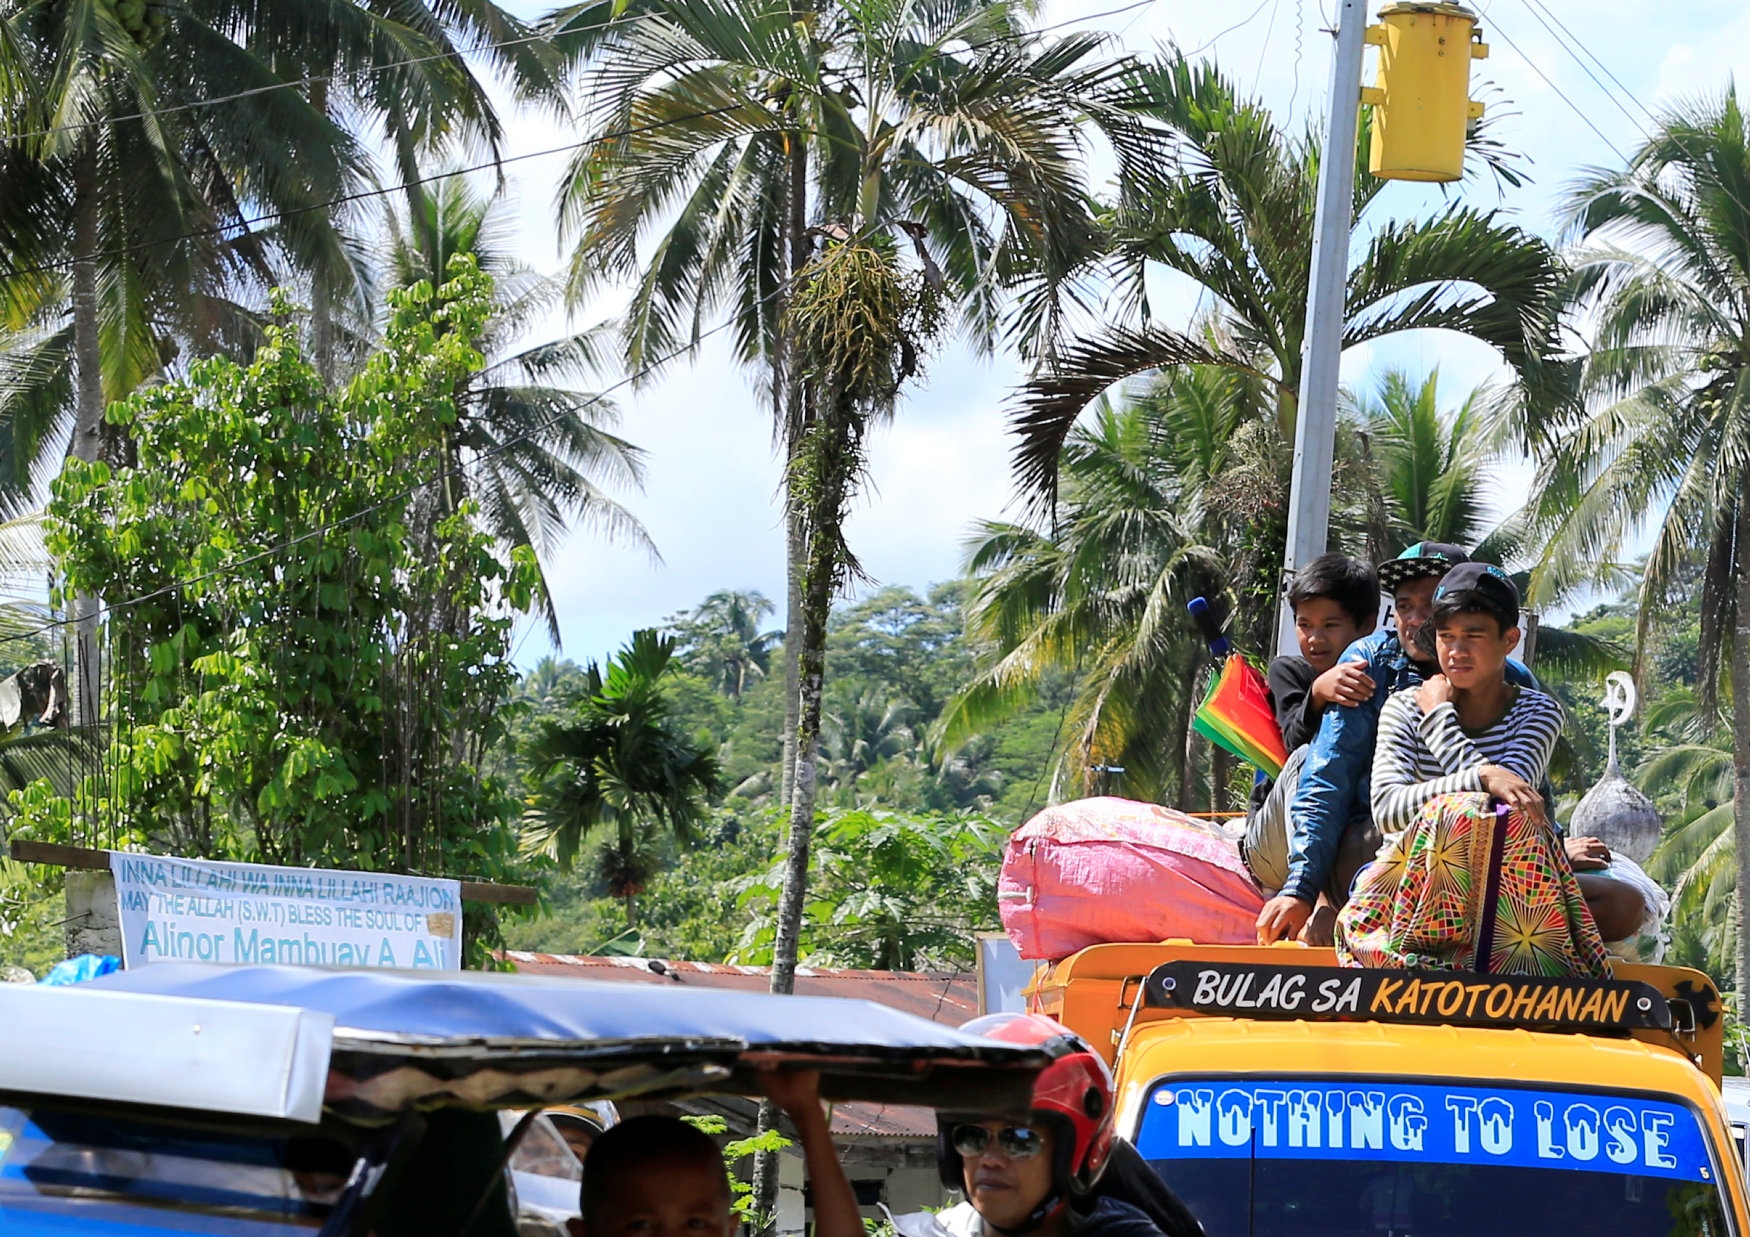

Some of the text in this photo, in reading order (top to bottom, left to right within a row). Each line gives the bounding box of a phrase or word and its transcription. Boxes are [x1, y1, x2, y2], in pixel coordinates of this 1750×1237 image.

[122, 859, 167, 887] INNA
[171, 864, 237, 891] LILLAHI
[242, 870, 269, 895] WA
[274, 874, 313, 899] INNA
[317, 878, 378, 902] LILLAHI
[121, 890, 422, 932] MAY THE ALLAH (S.W.T) BLESS THE SOUL OF
[140, 920, 225, 961] Alinor
[1193, 969, 1630, 1023] BULAG SA KATOTOHANAN
[1176, 1088, 1677, 1169] NOTHING TO LOSE
